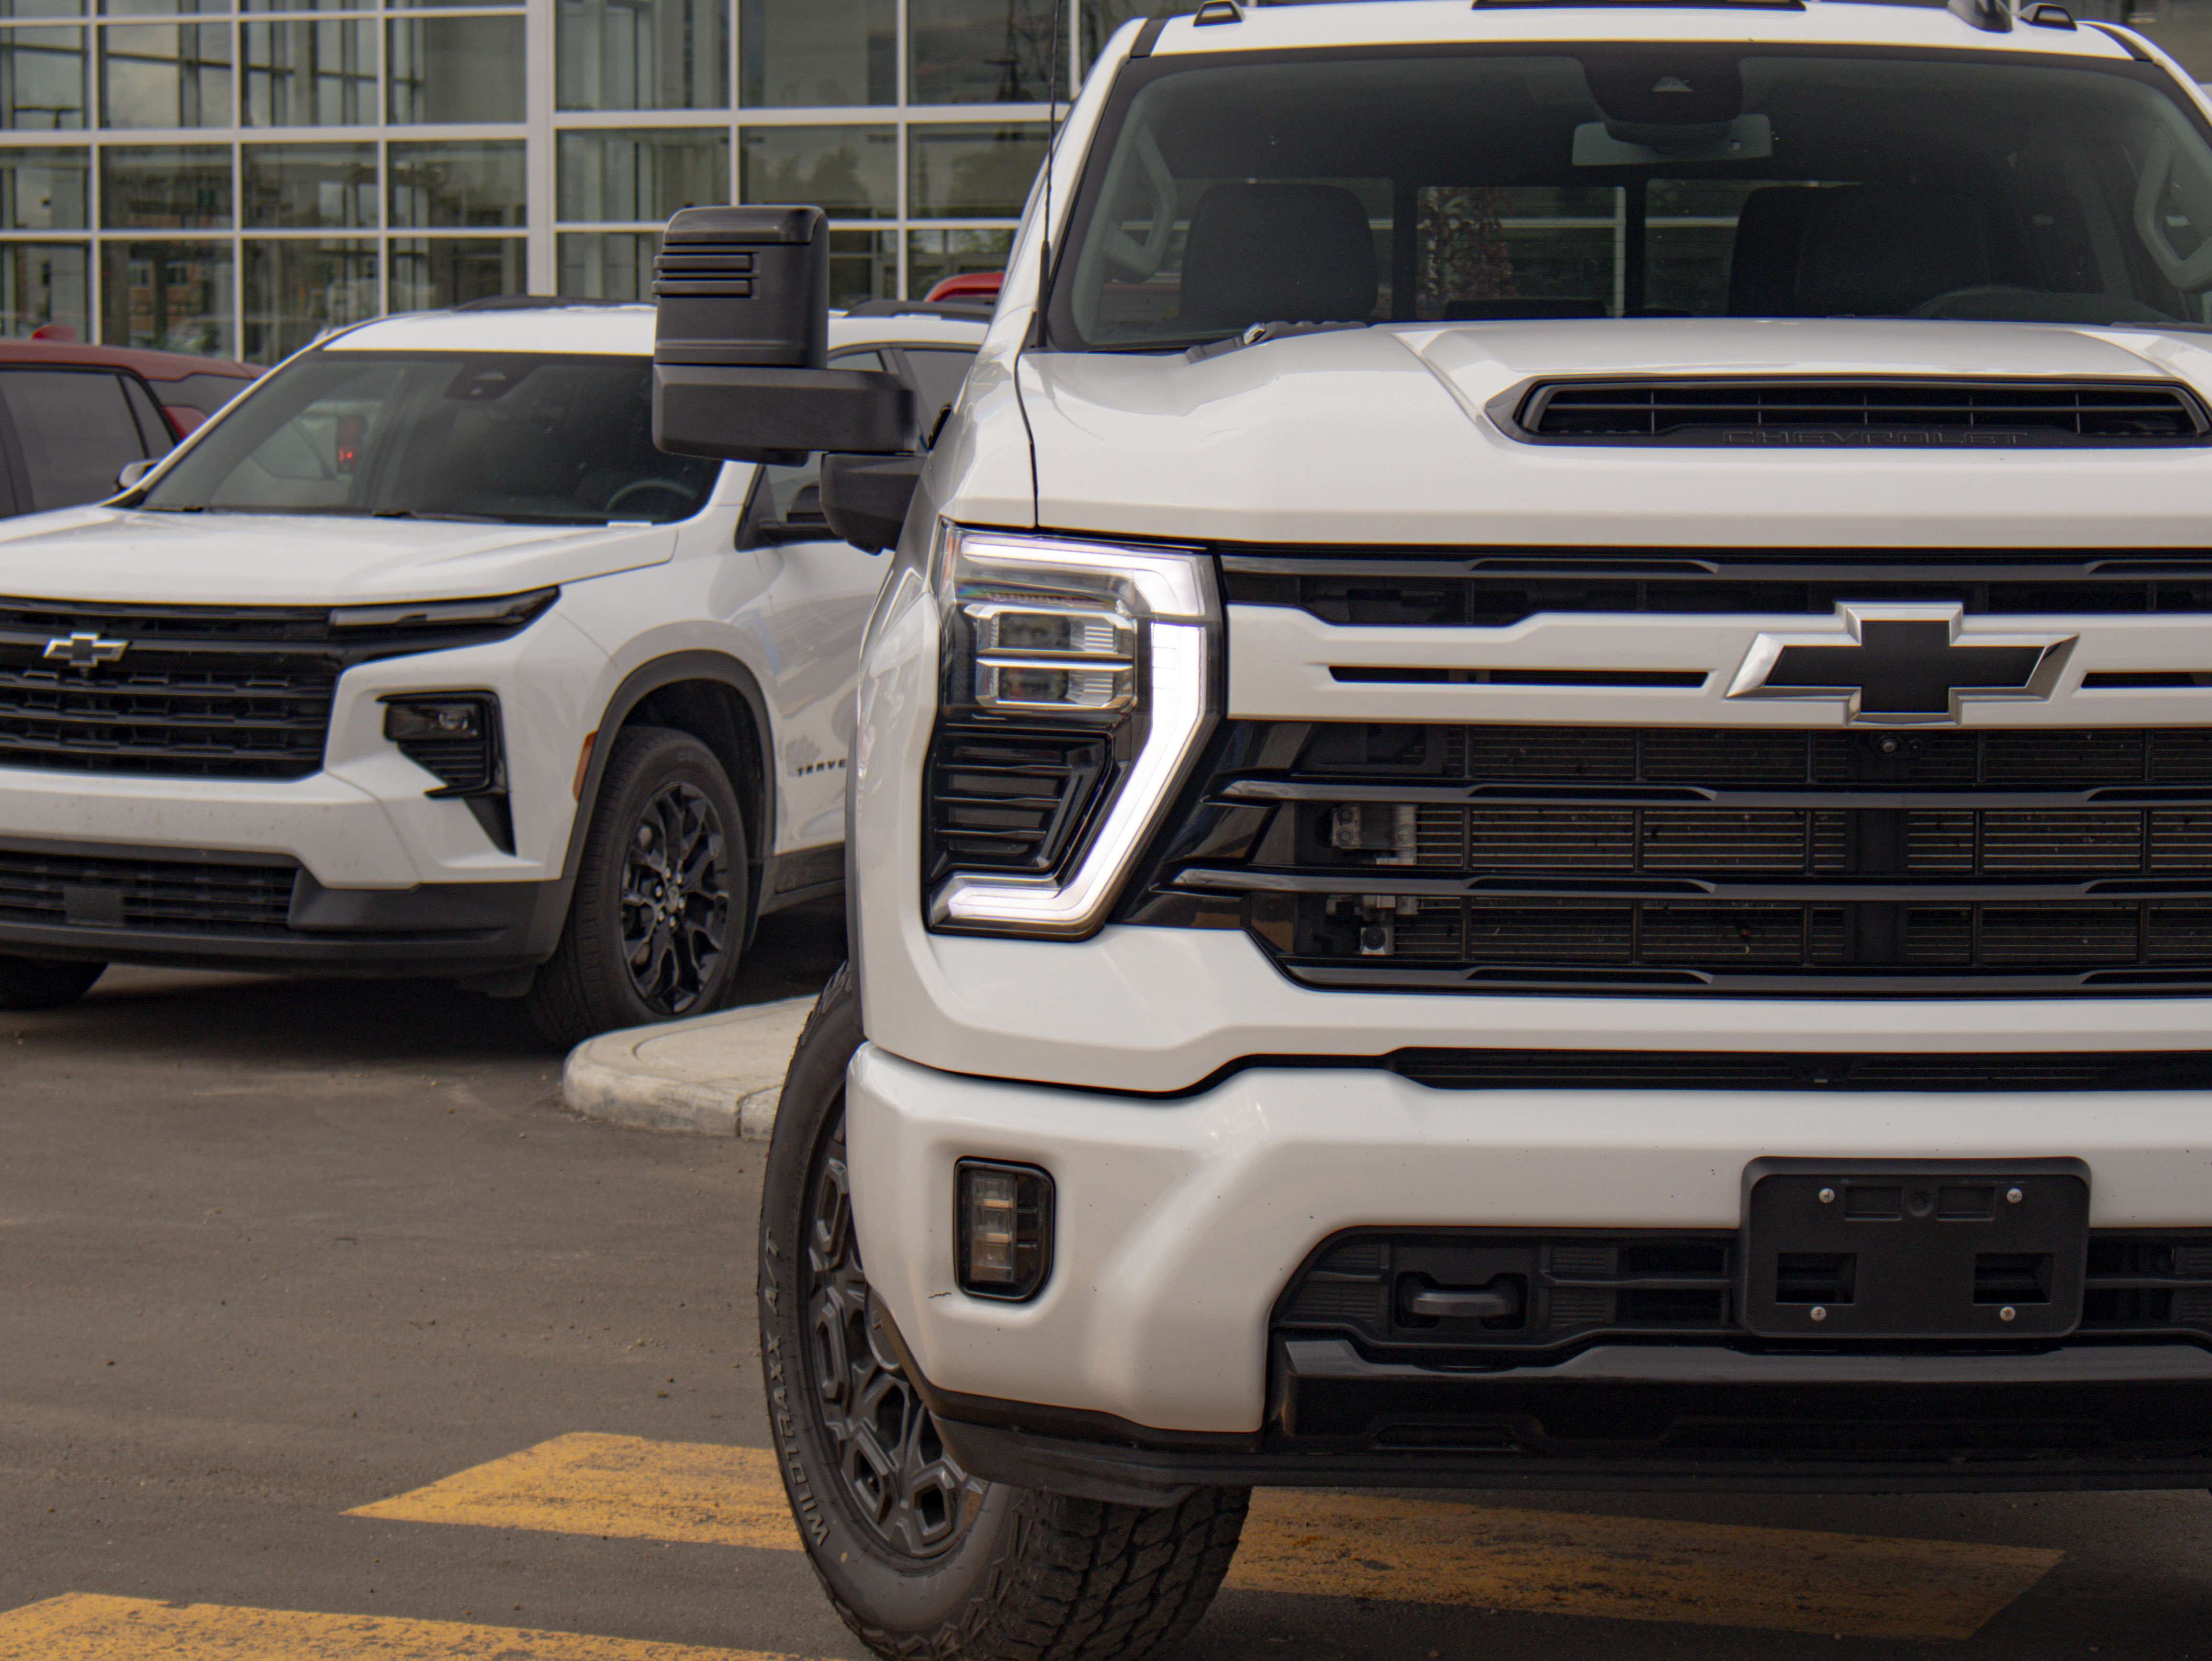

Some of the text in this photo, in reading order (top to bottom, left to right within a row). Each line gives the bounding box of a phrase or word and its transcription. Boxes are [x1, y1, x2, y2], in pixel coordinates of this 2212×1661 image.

[1723, 432, 2028, 444] CHEVROLET
[765, 1226, 830, 1547] WILDTRAXX A/T
